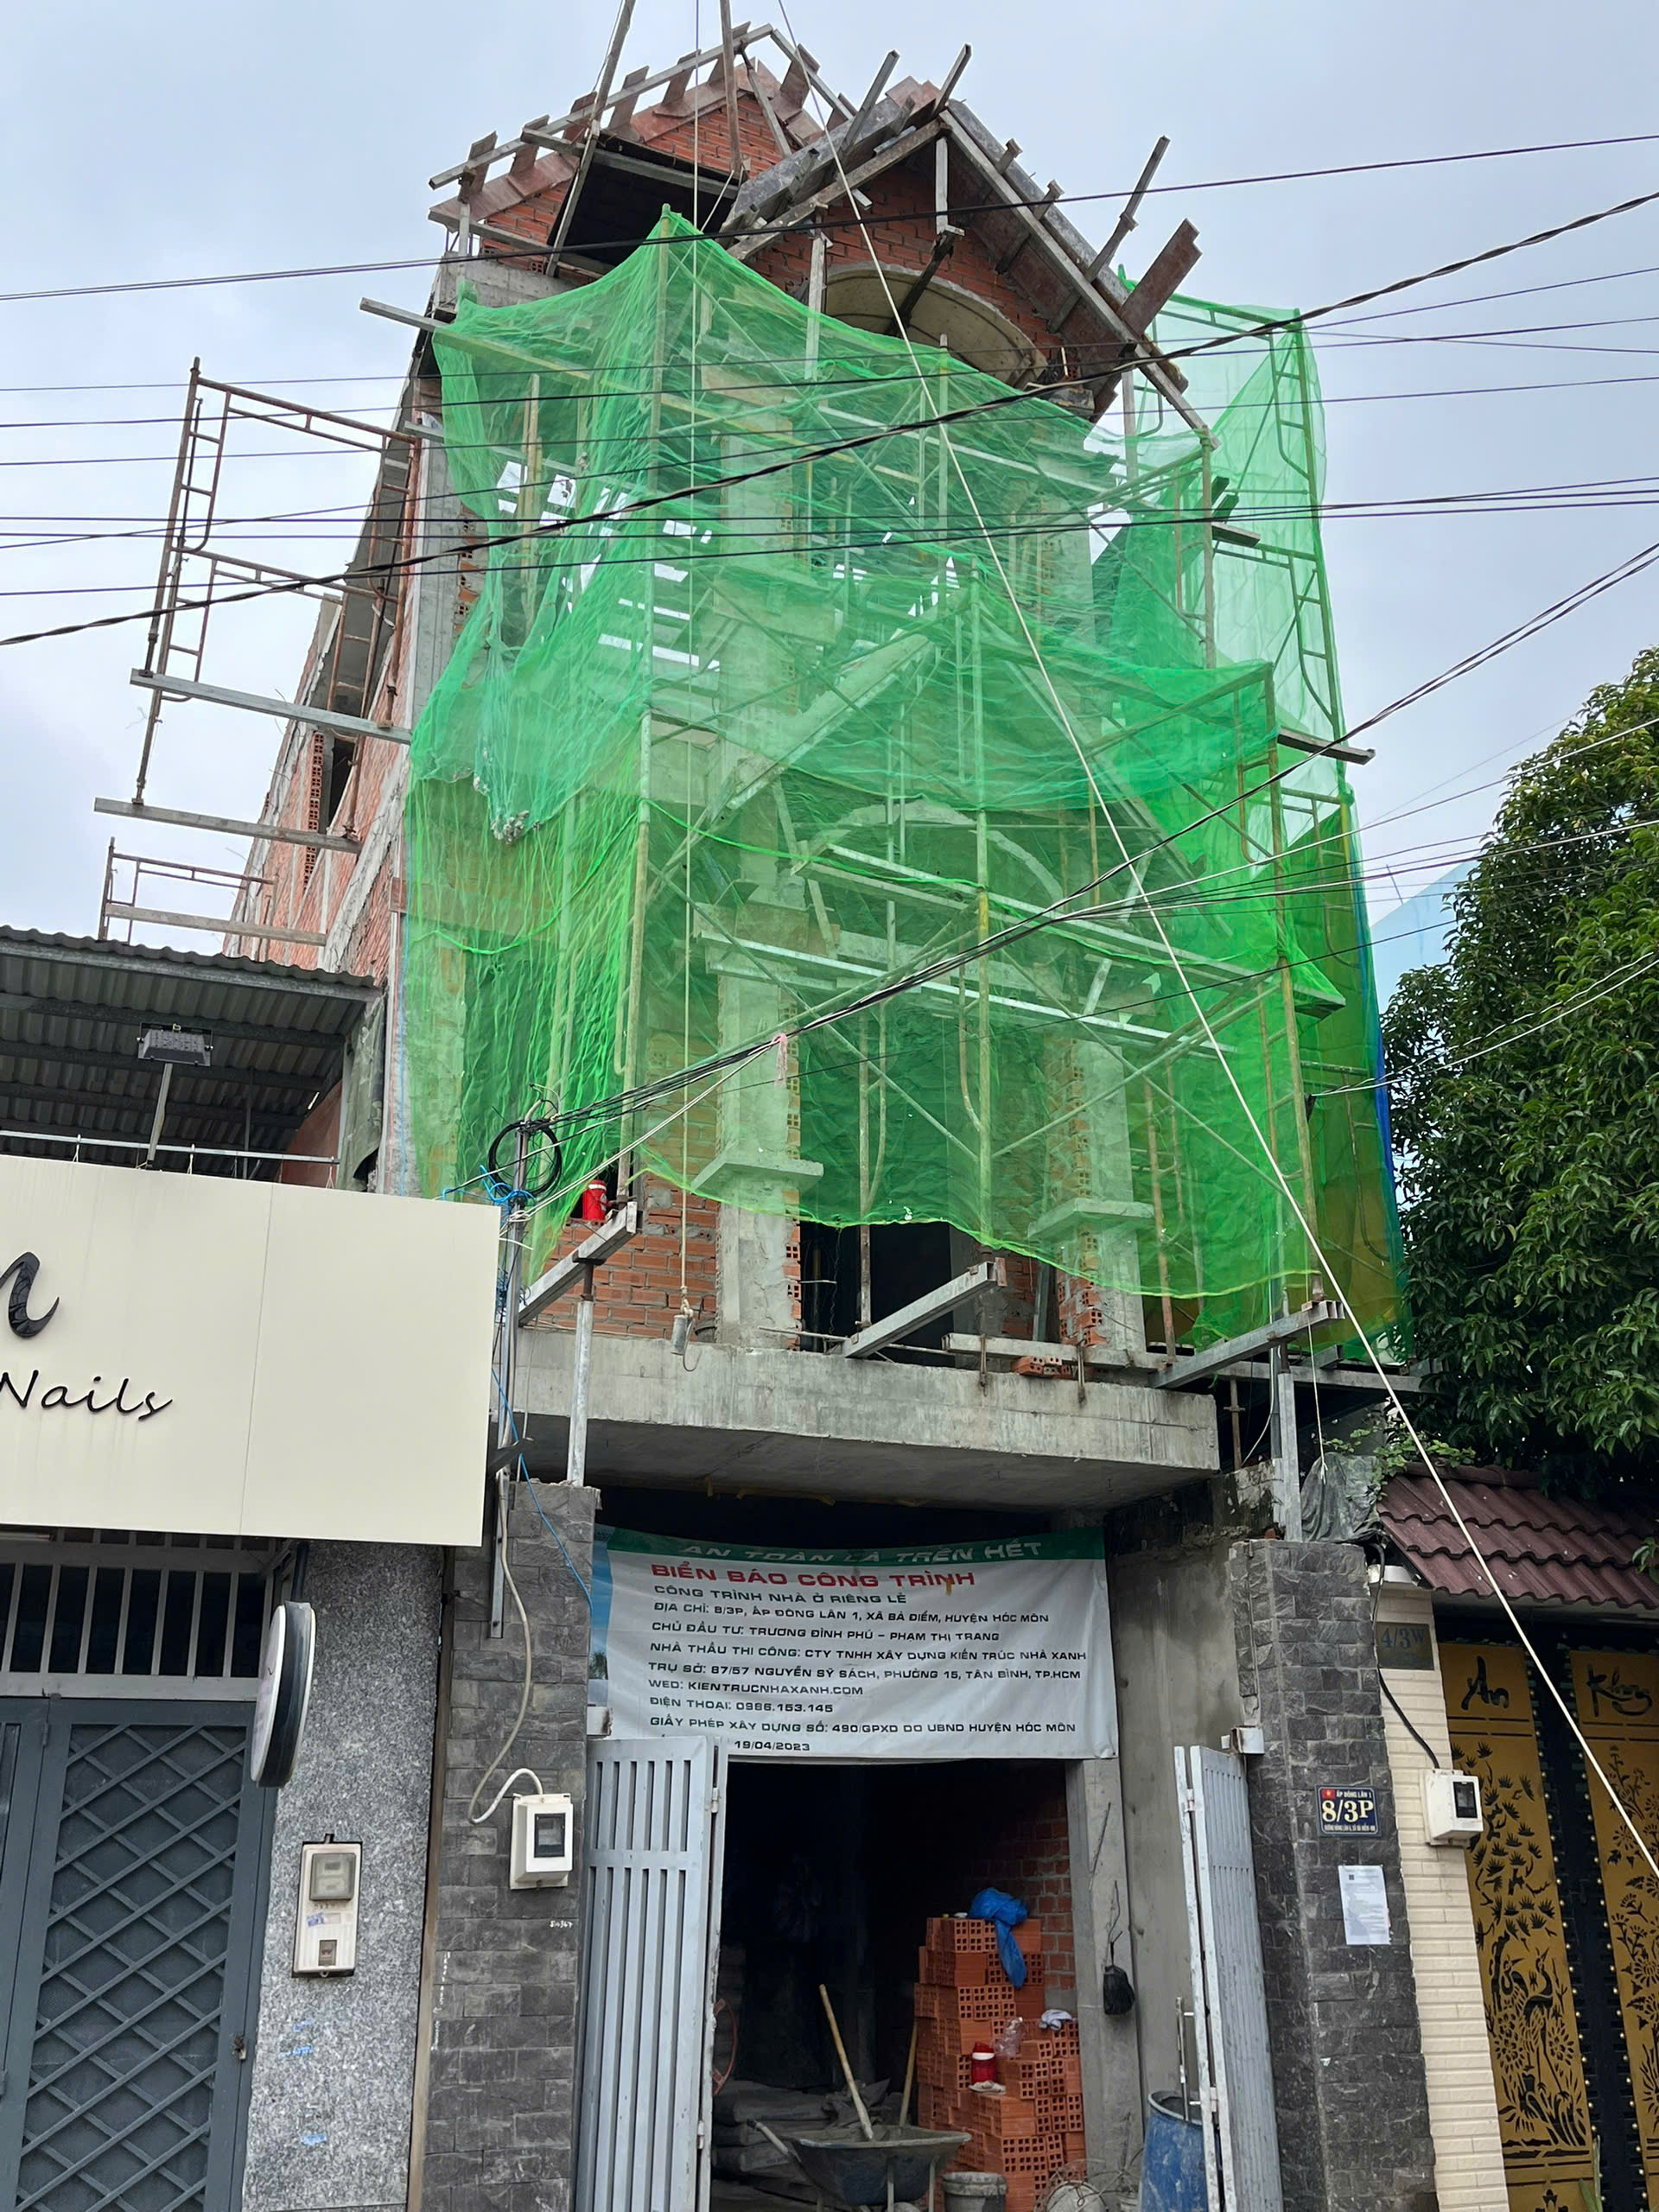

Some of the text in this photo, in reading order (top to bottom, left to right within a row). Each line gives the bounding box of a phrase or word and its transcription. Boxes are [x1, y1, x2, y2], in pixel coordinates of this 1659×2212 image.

[0, 1370, 173, 1421] Nails
[683, 1545, 732, 1557] AN
[651, 1560, 975, 1587] BIỂN BÁO CÔNG TRÌNH
[654, 1585, 703, 1597] CÔNG
[710, 1588, 762, 1601] TRÌNH
[769, 1592, 806, 1604] NHÀ
[830, 1593, 881, 1604] RIÊNG
[887, 1592, 906, 1604] LẺ
[654, 1602, 678, 1613] ĐỊA
[683, 1602, 709, 1613] CHỈ:
[820, 1610, 847, 1619] LÂN
[852, 1611, 862, 1622] 1,
[867, 1611, 884, 1621] XÃ
[909, 1610, 941, 1624] ĐIỂM,
[944, 1612, 988, 1624] HUYỆN
[993, 1611, 1017, 1623] HÓC
[1020, 1612, 1049, 1623] MÔN
[652, 1619, 682, 1632] CHỦ
[686, 1621, 717, 1633] ĐẦU
[722, 1624, 744, 1635] TƯ:
[811, 1627, 842, 1638] ĐÌNH
[847, 1627, 874, 1639] PHÚ
[890, 1632, 926, 1643] PHẠM
[931, 1633, 951, 1643] THỊ
[956, 1632, 999, 1642] TRANG
[650, 1641, 1086, 1662] NHÀ THẦU THI CÔNG: CTY TNHH XÂY DỰNG KIẾN TRÚC NHÀ XANH
[648, 1662, 1081, 1681] TRỤ SỞ: 87/57 NGUYỄN SỸ SÁCH, PHƯỜNG 15, TÂN BÌNH, TP.HCM
[688, 1681, 863, 1695] KIENTRUCNHAXANH.COM
[650, 1696, 681, 1707] ĐIỆN
[687, 1700, 731, 1711] THOẠI:
[650, 1713, 1076, 1733] GIẤY PHÉP XÂY DỰNG SỐ: 490/GPXD DO UBND HUYỆN HÓC MÔN
[734, 1740, 810, 1751] 19/04/2023
[1322, 1799, 1374, 1822] 8/3P
